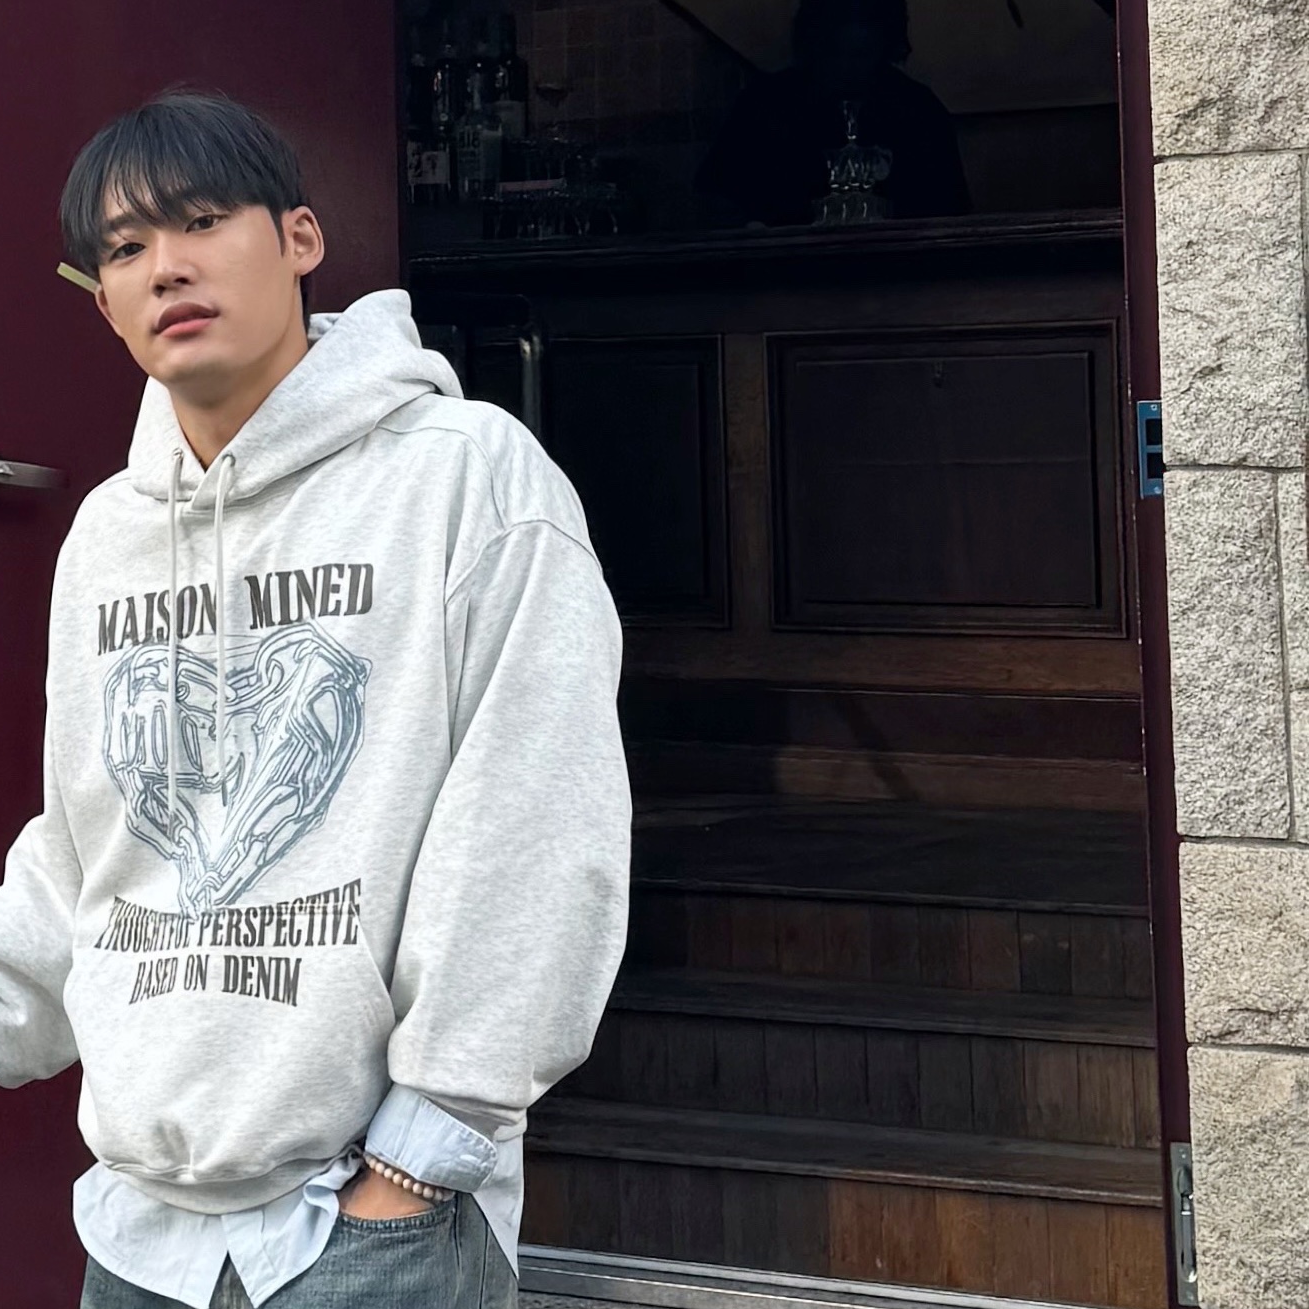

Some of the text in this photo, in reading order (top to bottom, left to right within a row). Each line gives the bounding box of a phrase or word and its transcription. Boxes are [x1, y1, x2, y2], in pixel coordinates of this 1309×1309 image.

[97, 563, 373, 656] MAISON MINED
[197, 878, 361, 947] PERSPECTIVE
[129, 954, 302, 1007] BASED ON DENIM
